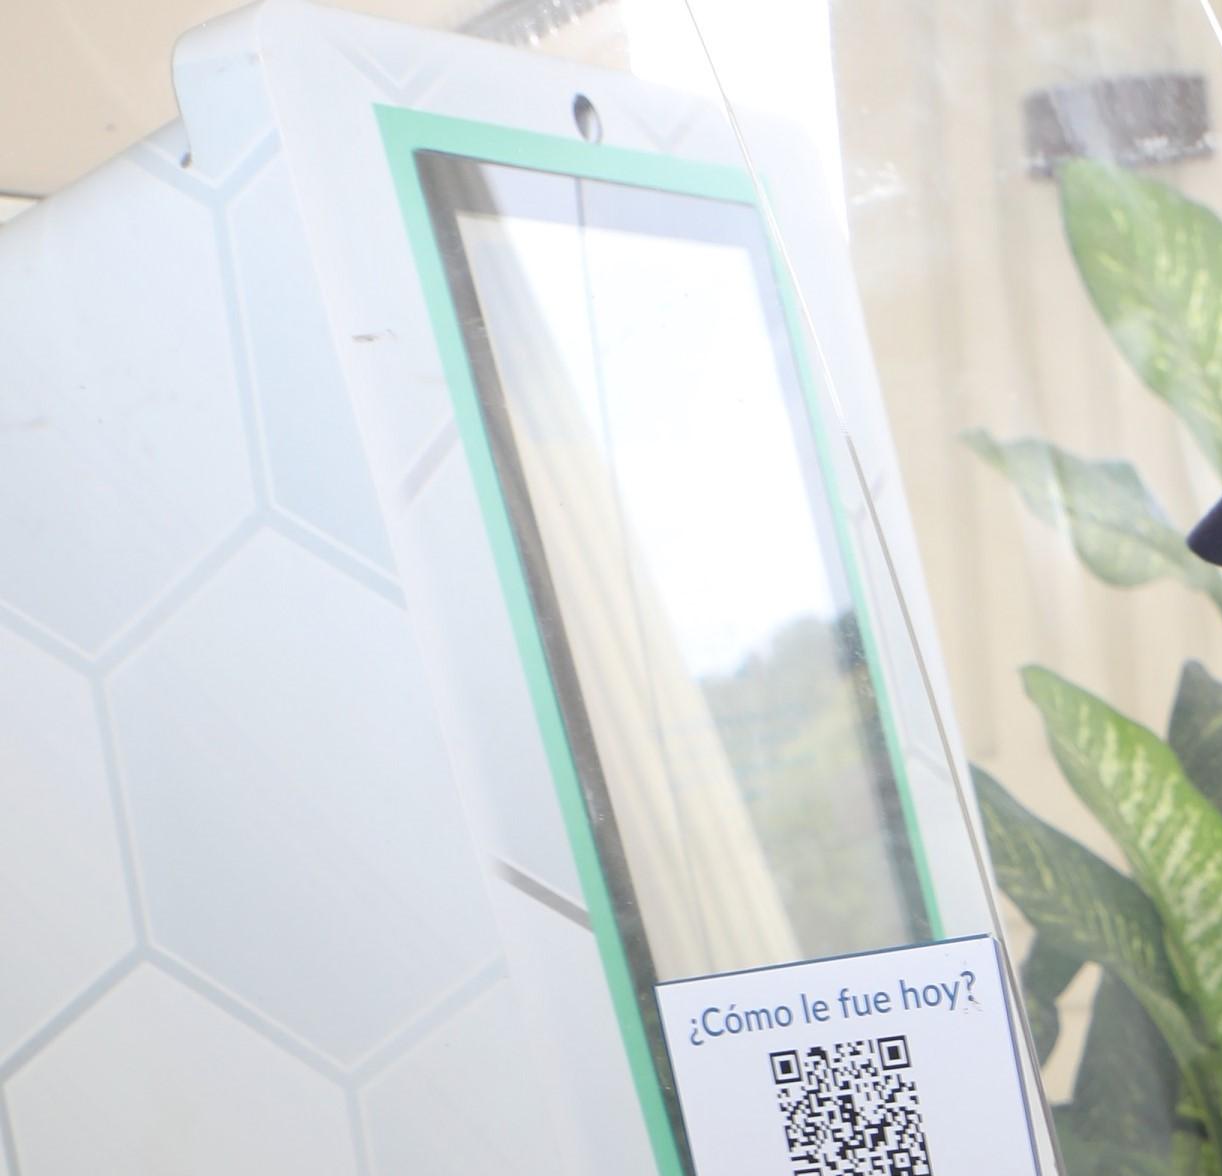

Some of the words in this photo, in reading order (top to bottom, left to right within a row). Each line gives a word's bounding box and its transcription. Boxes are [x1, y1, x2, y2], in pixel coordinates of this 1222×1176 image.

[689, 1004, 793, 1046] ¿Cómo
[801, 993, 830, 1024] le
[838, 988, 891, 1018] fue
[900, 971, 976, 1011] hoy?
